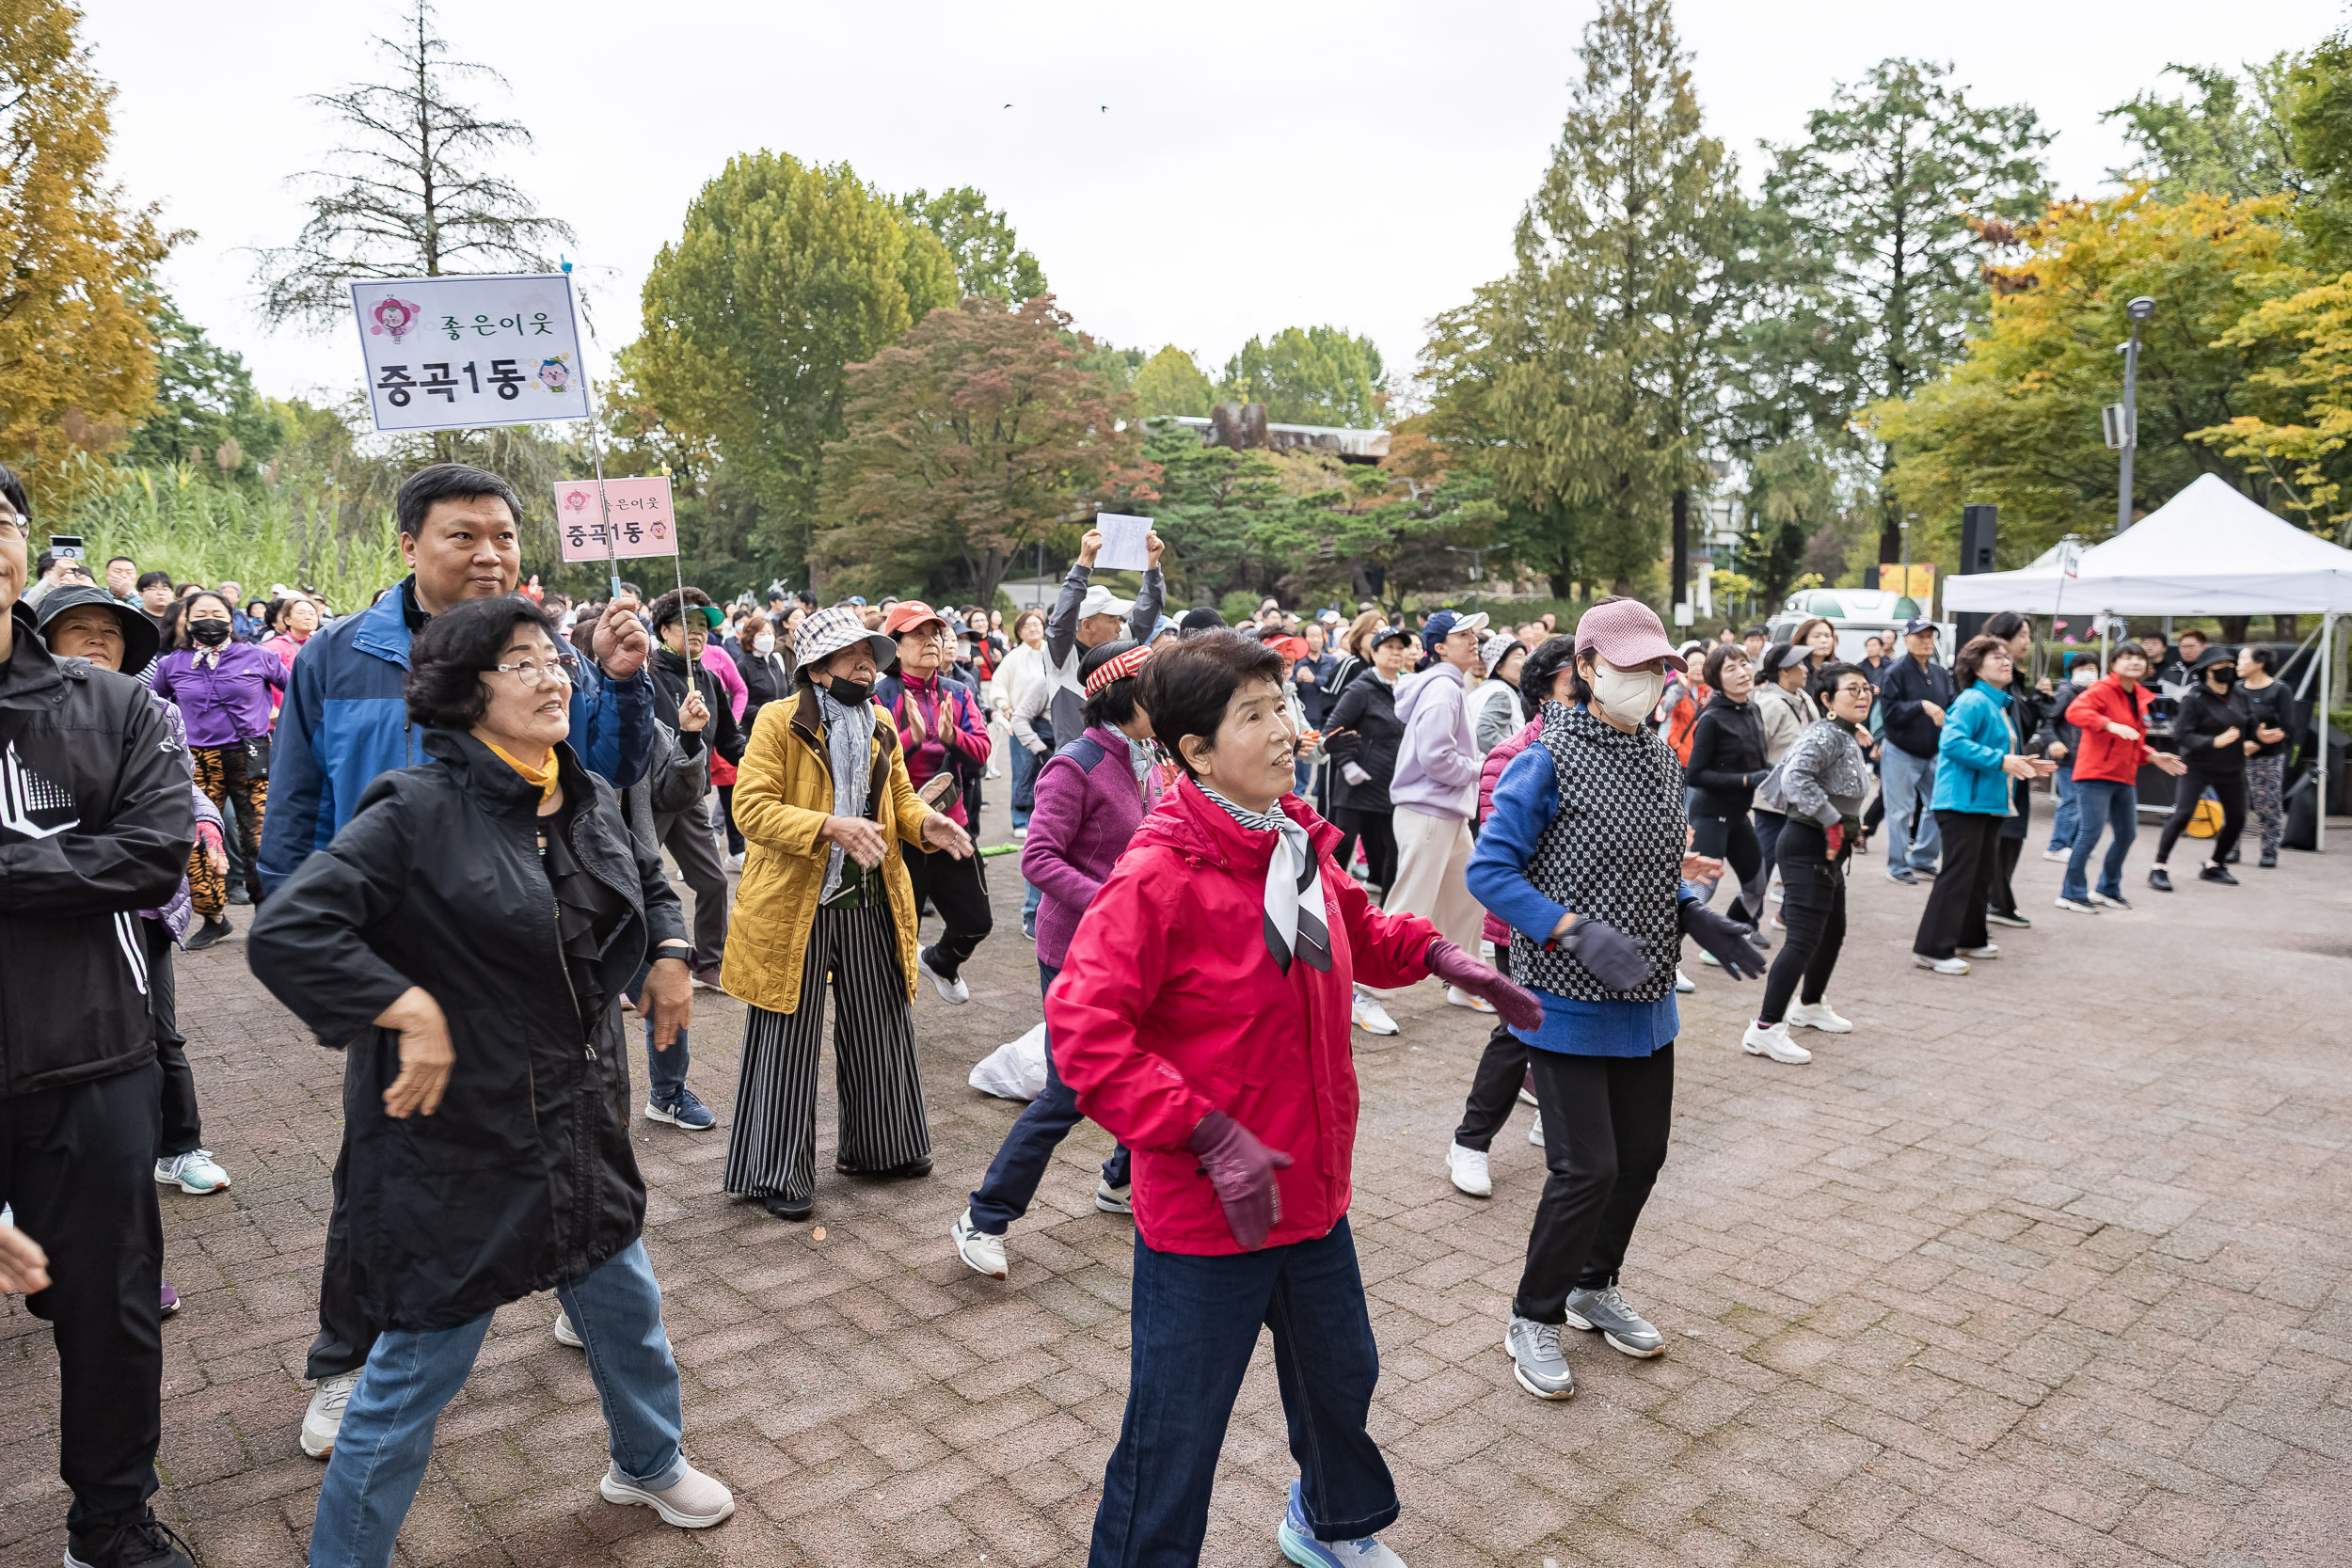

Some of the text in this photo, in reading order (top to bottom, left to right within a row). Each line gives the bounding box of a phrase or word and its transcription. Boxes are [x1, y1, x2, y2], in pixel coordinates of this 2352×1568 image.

[441, 312, 554, 341] 좋은이웃
[377, 358, 526, 407] 중곡1동
[566, 522, 644, 547] 중곡1동
